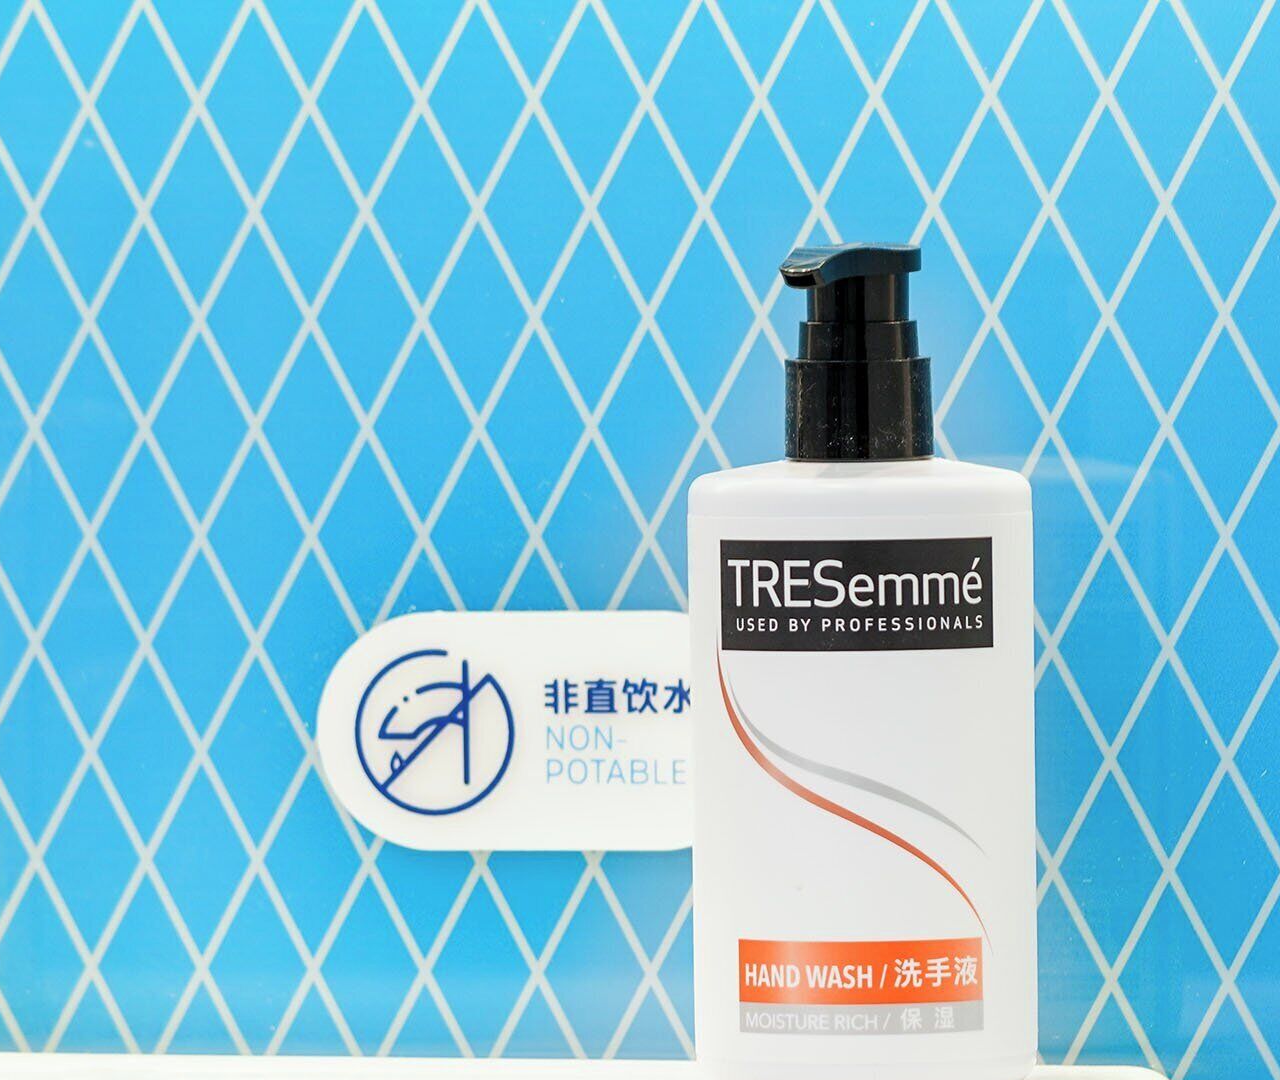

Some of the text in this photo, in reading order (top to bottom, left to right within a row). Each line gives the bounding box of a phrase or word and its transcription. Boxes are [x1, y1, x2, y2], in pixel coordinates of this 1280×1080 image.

[727, 556, 983, 608] TRESemmé
[735, 614, 984, 632] USED BY PROFESSIONALS
[545, 725, 628, 751] NON-
[545, 758, 687, 785] POTABLE
[745, 955, 979, 989] HAND WASH / 洗手液
[745, 1011, 830, 1031] MOISTURE
[834, 1012, 879, 1031] RICH
